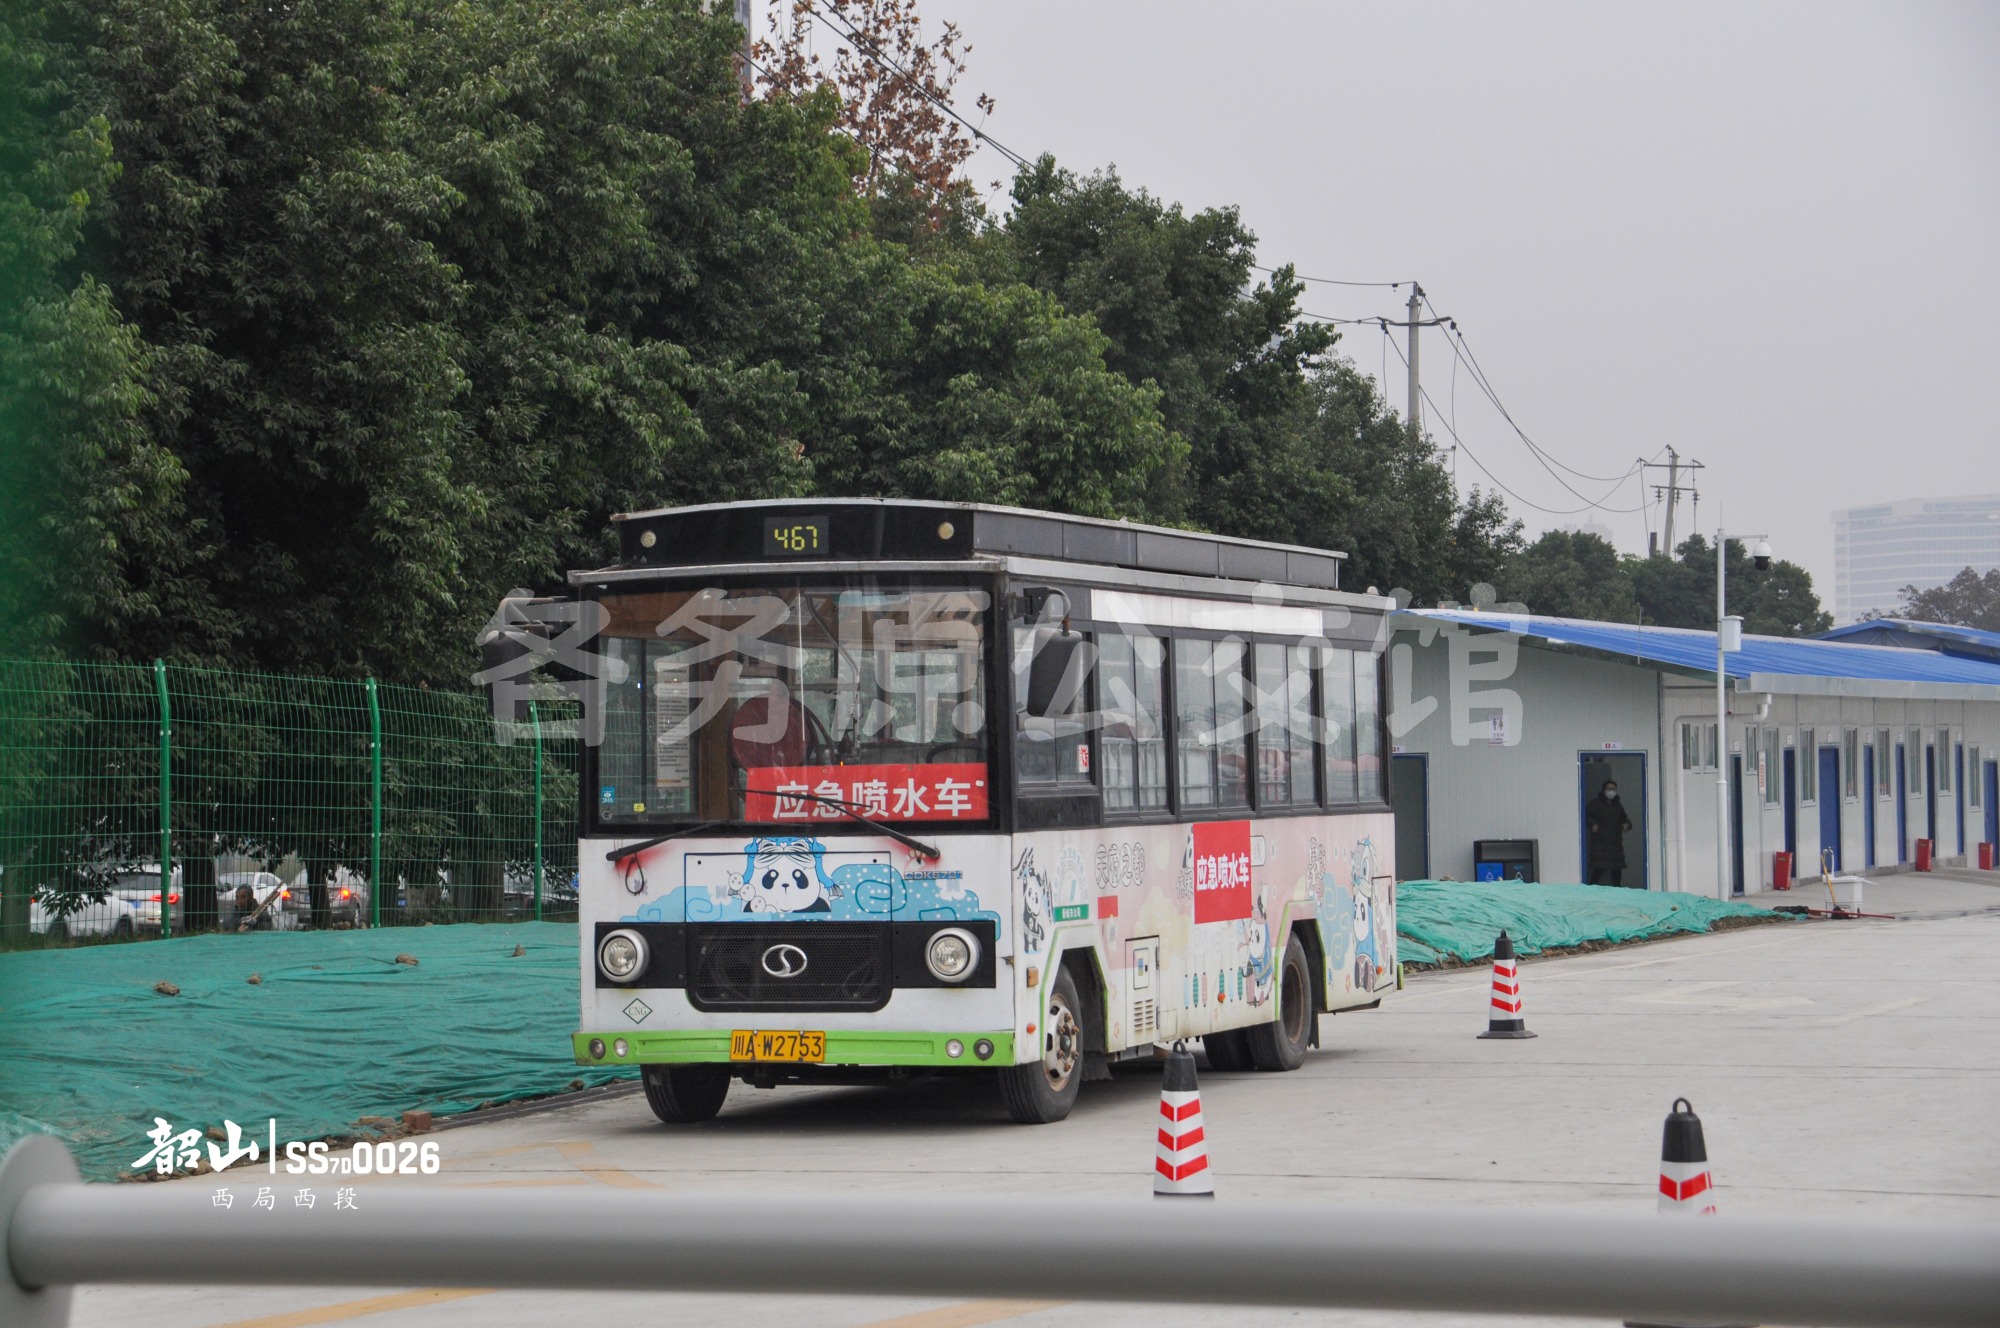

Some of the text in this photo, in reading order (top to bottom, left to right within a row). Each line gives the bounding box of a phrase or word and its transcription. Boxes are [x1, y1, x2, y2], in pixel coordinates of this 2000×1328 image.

[774, 525, 818, 551] 467
[773, 778, 972, 819] 应急喷水车
[1196, 852, 1250, 891] 应急喷水车
[628, 1006, 648, 1016] CNG
